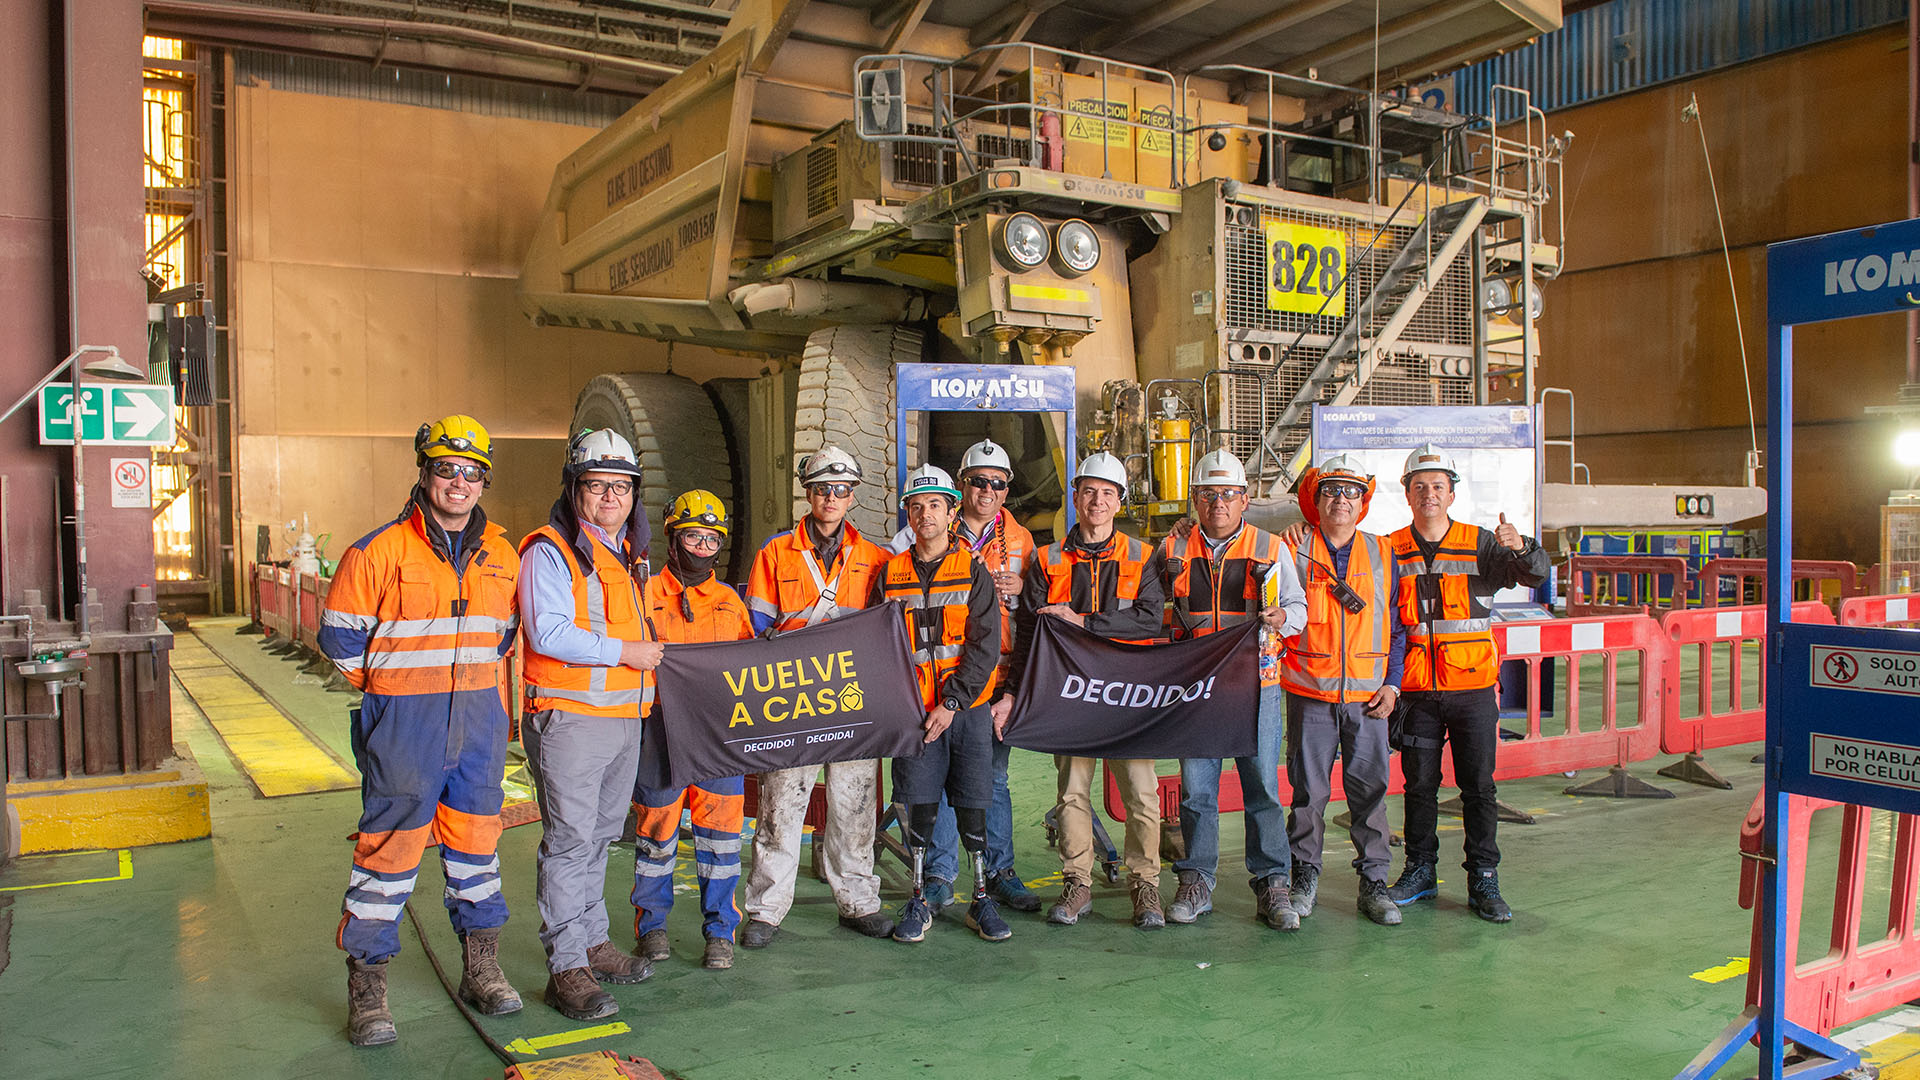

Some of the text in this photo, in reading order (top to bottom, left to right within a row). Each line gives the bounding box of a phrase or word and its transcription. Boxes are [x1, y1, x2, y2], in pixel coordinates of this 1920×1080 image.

[608, 142, 672, 207] ELIGE TU DESTINO
[1078, 182, 1145, 200] MATSU
[609, 258, 629, 291] ELIGE
[630, 238, 672, 283] SEGURIDAD
[1272, 240, 1341, 298] 828
[931, 374, 1044, 398] KOMATSU
[1323, 412, 1376, 422] KOMATSU
[722, 650, 857, 697] VUELVE
[1870, 657, 1916, 672] SOLO
[1060, 674, 1216, 708] DECIDIDO!
[1884, 674, 1920, 688] AUT
[728, 702, 754, 728] A
[744, 730, 855, 753] DECIDIDO! DECIDIDA!
[1834, 744, 1859, 758] NO
[1825, 758, 1860, 775] POR
